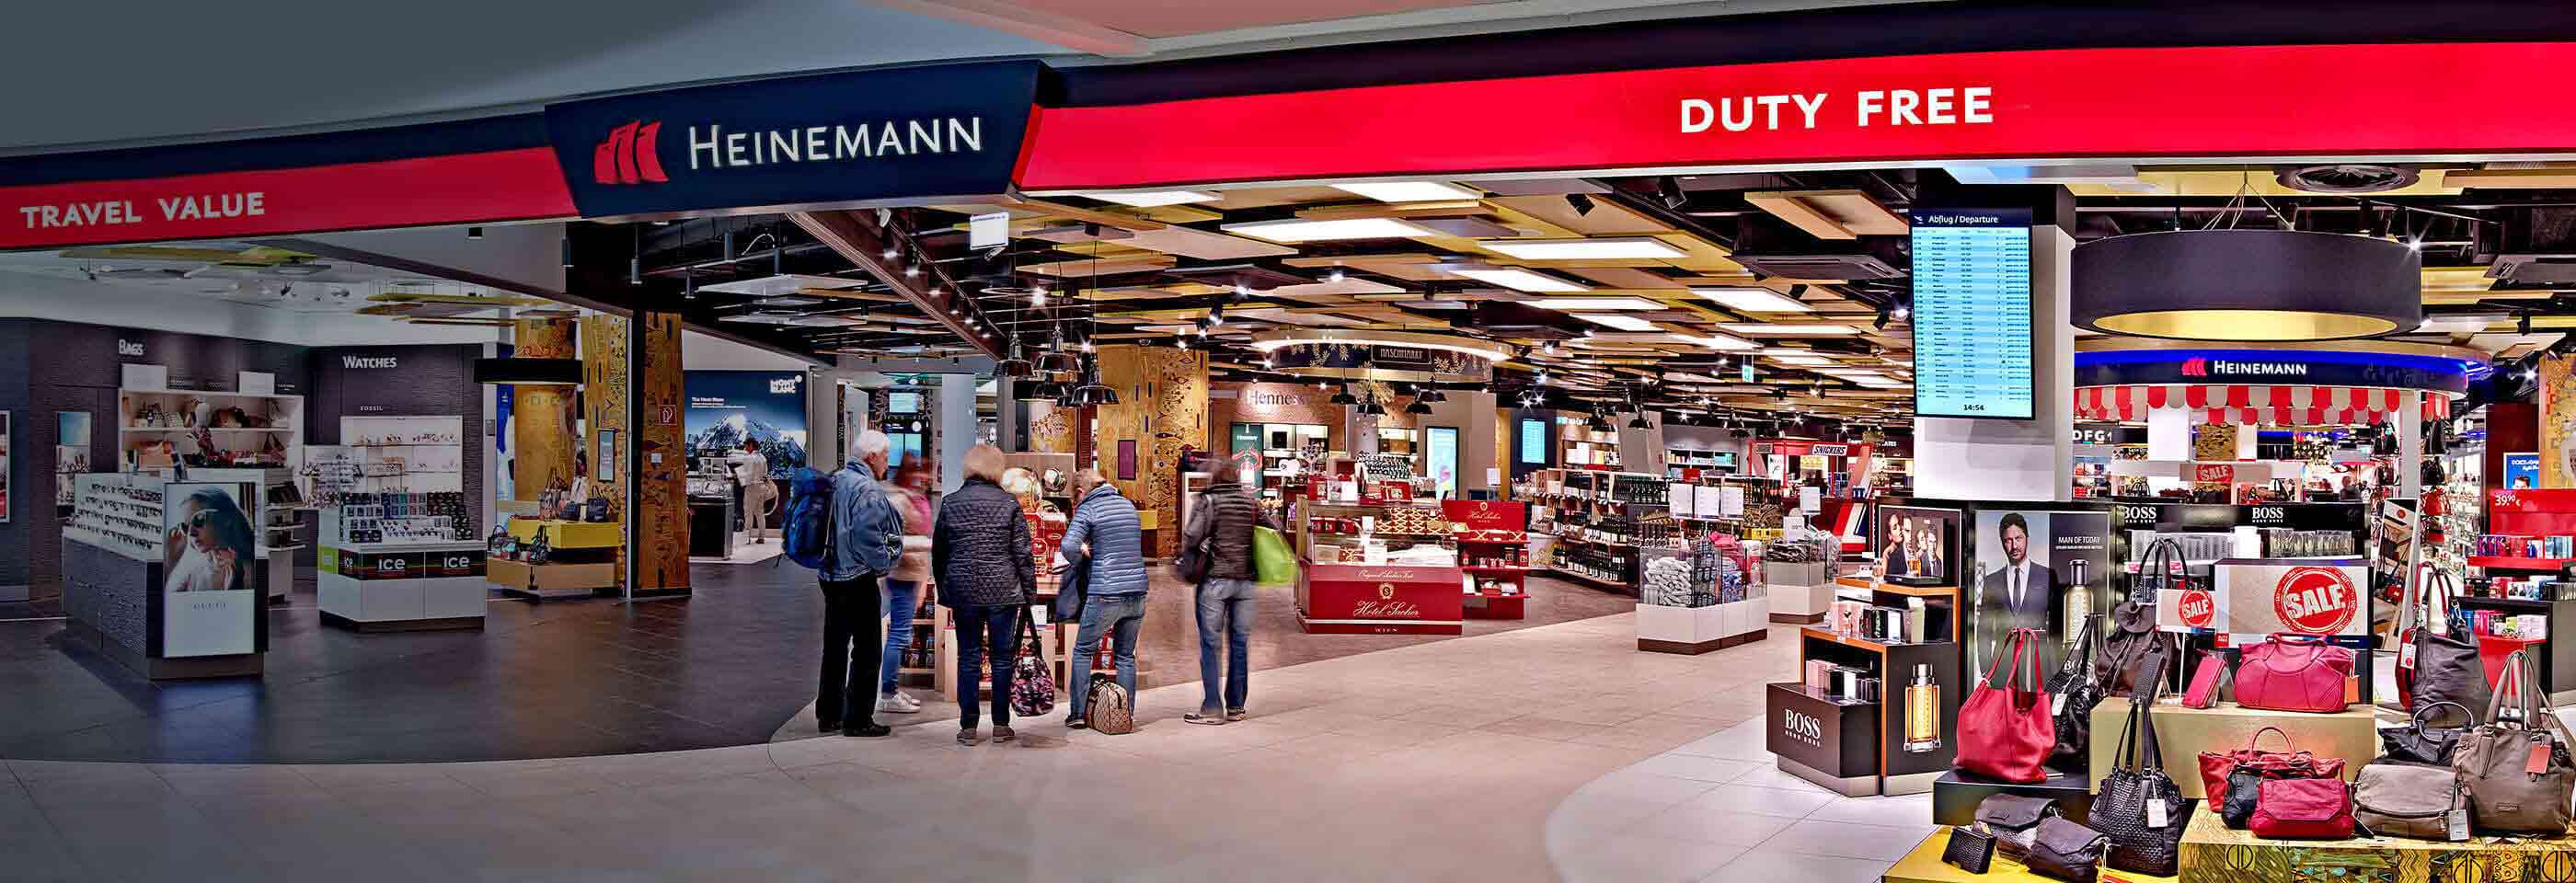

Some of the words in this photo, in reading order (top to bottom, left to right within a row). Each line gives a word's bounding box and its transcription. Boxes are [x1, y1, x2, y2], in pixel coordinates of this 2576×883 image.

[1681, 93, 1828, 133] DUTY
[1857, 86, 1994, 127] FREE
[689, 117, 982, 170] HEINEMANN
[20, 201, 142, 229] TRAVEL
[158, 191, 265, 222] VALUE
[1928, 215, 1953, 224] Abflug
[1959, 215, 1999, 224] Departure
[342, 355, 397, 369] WATCHES
[2214, 360, 2306, 375] HEINEMANN
[1813, 445, 1846, 455] SNICKERS
[2252, 507, 2283, 519] BOSS
[1353, 601, 1390, 617] Hotel
[2182, 599, 2209, 619] SALE
[2283, 583, 2347, 620] SALE
[1785, 708, 1821, 740] BOSS
